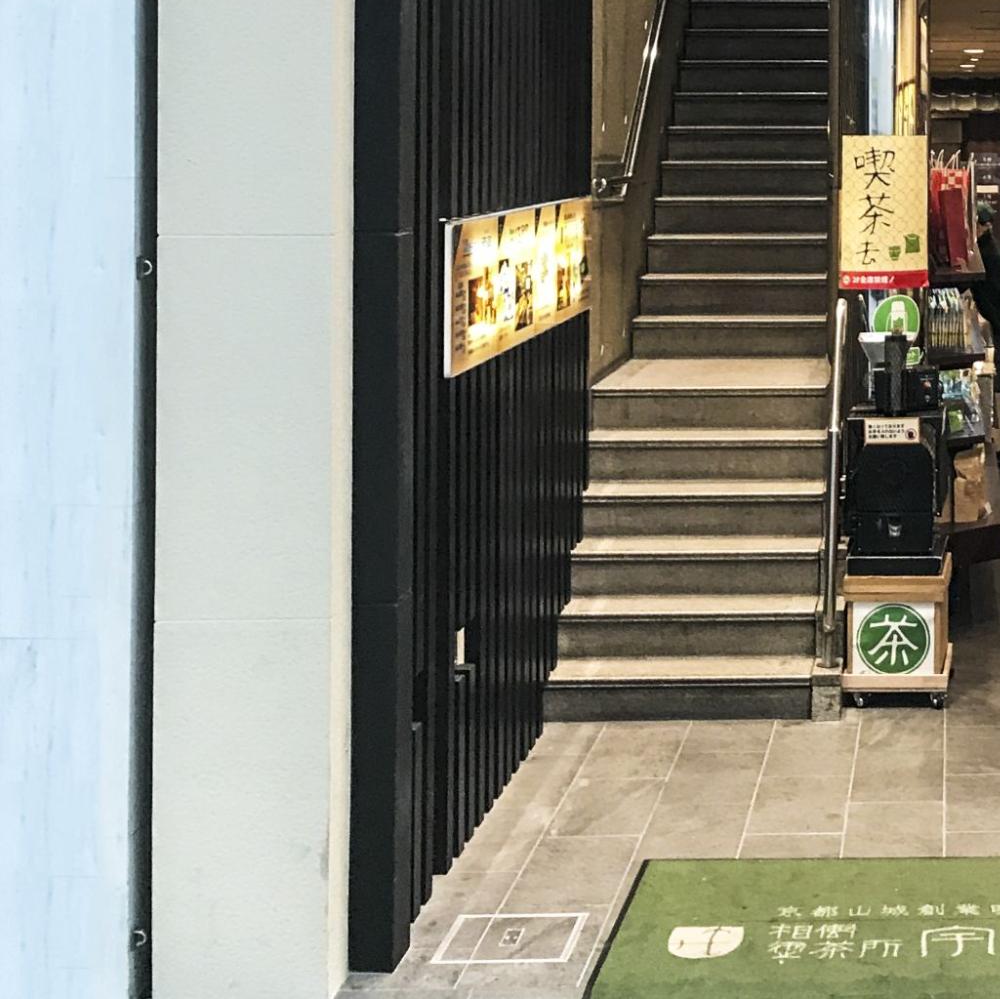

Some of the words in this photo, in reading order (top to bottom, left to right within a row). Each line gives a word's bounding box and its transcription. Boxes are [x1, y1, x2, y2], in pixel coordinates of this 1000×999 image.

[854, 146, 896, 266] 喫茶去
[867, 613, 919, 666] 茶
